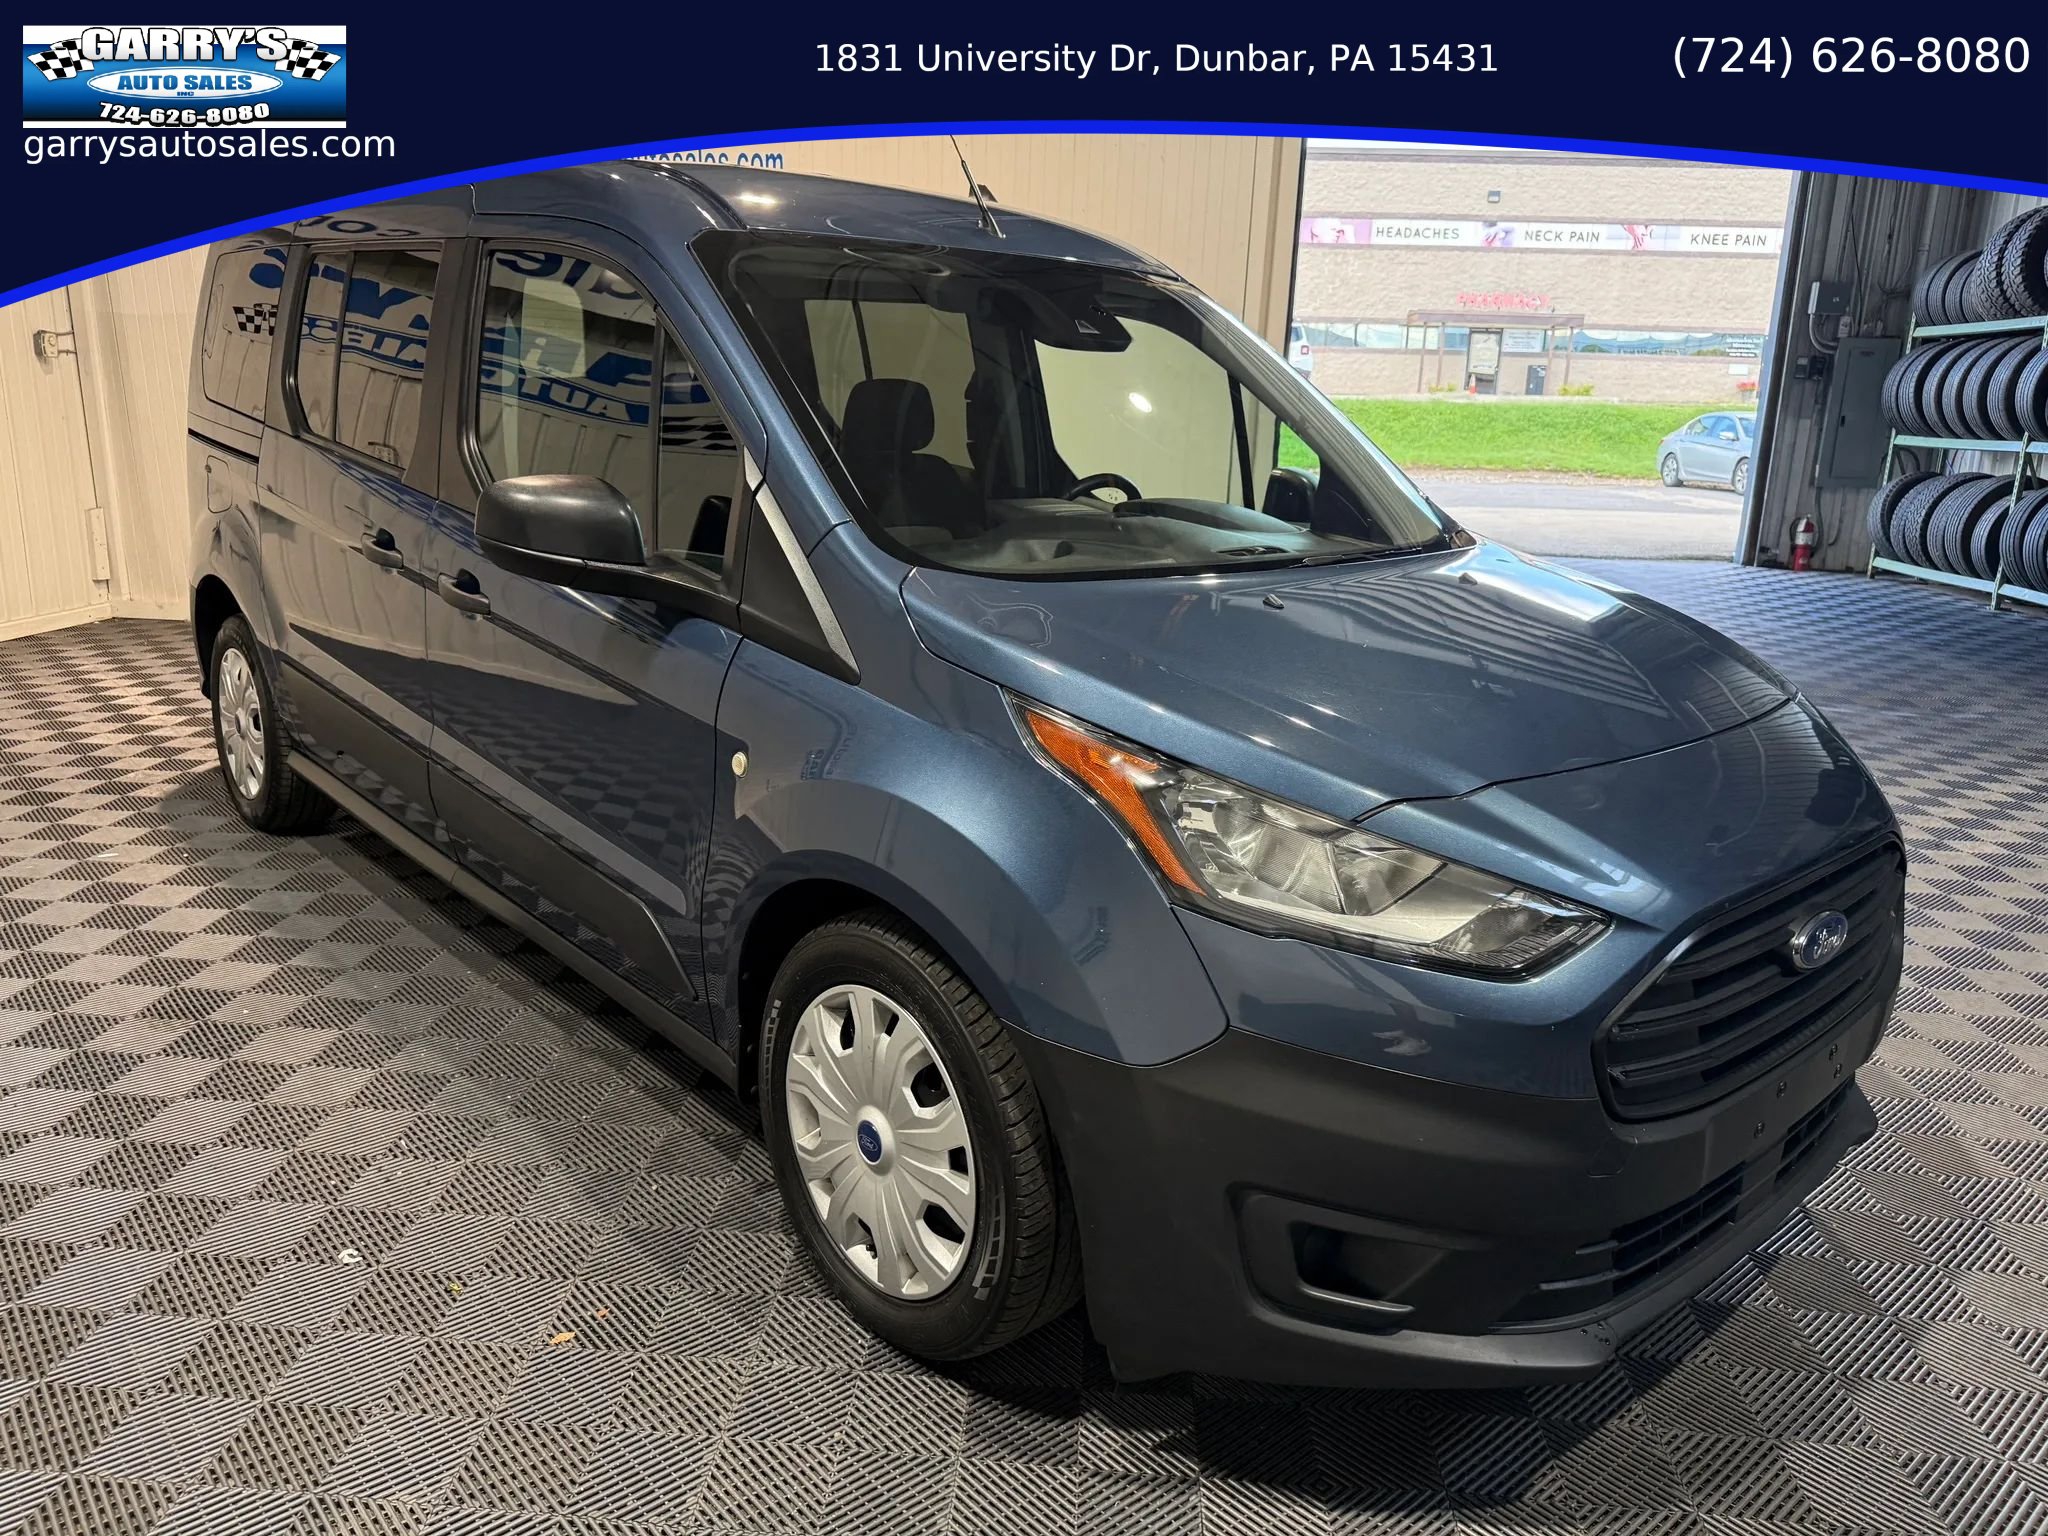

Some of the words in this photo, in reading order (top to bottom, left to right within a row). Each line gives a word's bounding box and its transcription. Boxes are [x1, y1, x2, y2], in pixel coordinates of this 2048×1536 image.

[1375, 226, 1460, 239] HEADACHES
[1523, 230, 1563, 242] NECK
[1568, 231, 1600, 243] PAIN
[1690, 233, 1730, 246] KNEE
[1734, 234, 1767, 247] PAIN
